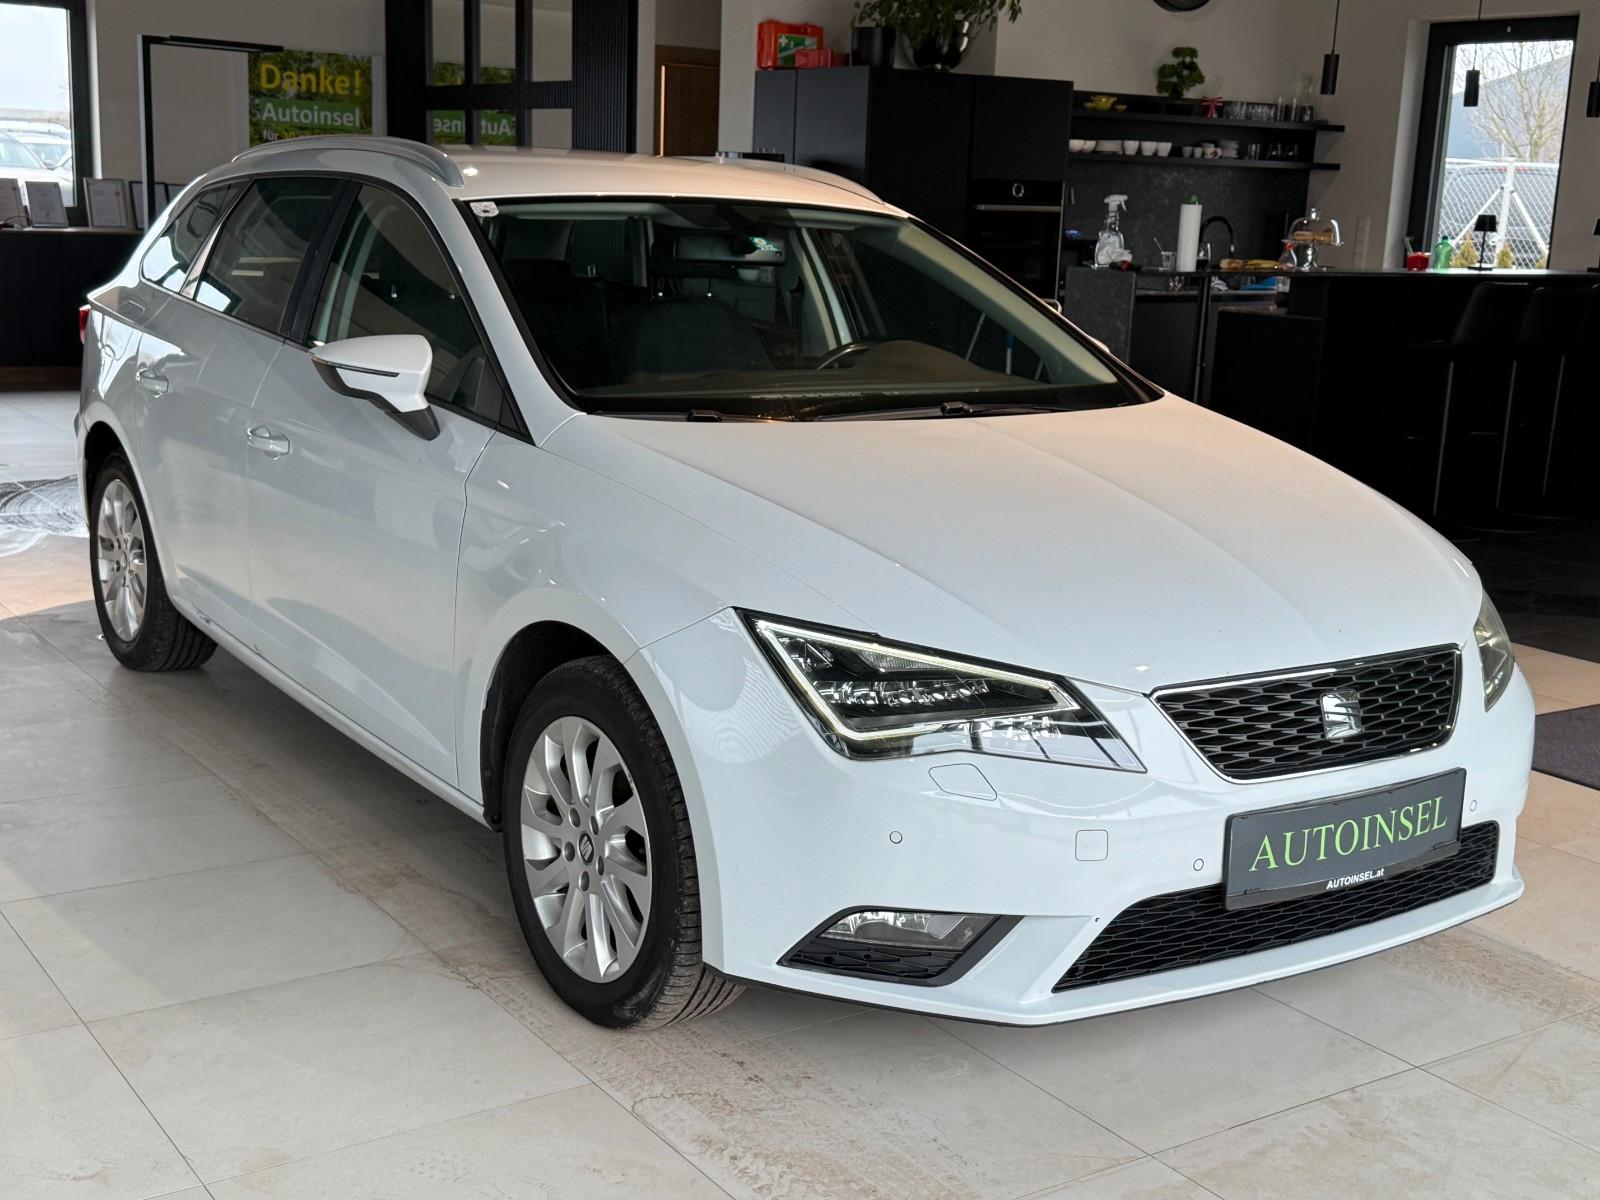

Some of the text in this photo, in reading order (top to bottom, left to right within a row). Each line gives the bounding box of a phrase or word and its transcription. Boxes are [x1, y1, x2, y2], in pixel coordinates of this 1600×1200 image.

[260, 62, 362, 97] Danke!
[262, 102, 361, 128] Autoinsel
[1249, 796, 1448, 872] AUTOINSEL
[1326, 868, 1385, 890] AUTOINSEL.at
